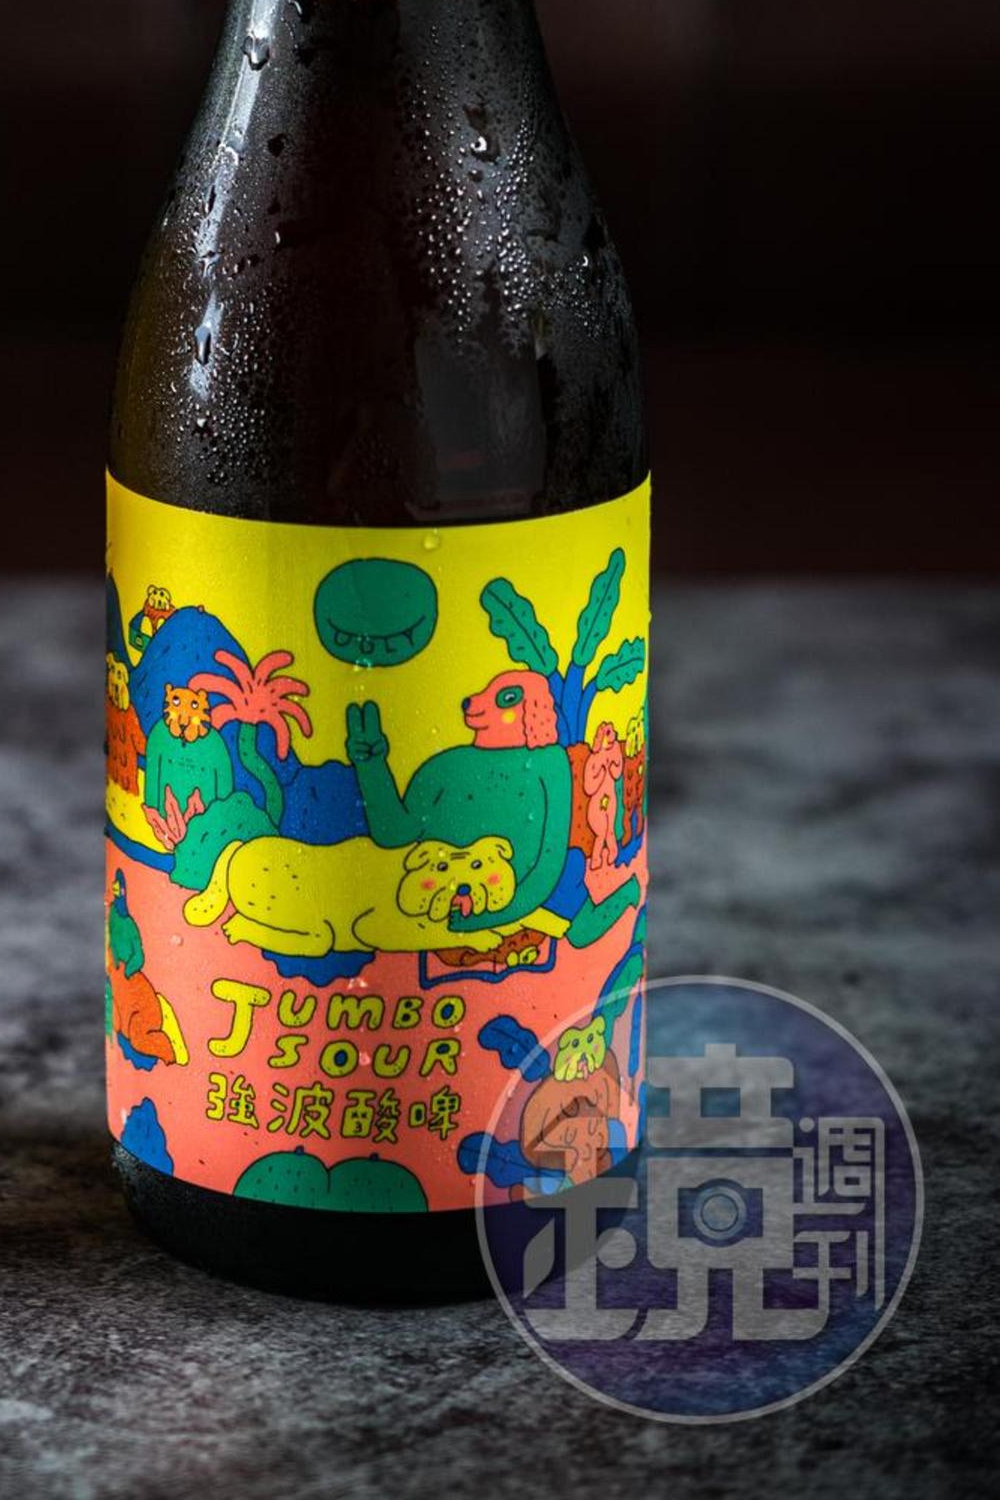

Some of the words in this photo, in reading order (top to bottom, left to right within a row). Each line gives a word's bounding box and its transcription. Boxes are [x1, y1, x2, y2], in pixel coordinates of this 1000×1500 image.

[207, 977, 466, 1058] JUMBO
[267, 1033, 462, 1079] SOUR
[205, 1071, 462, 1144] 強波酸啤
